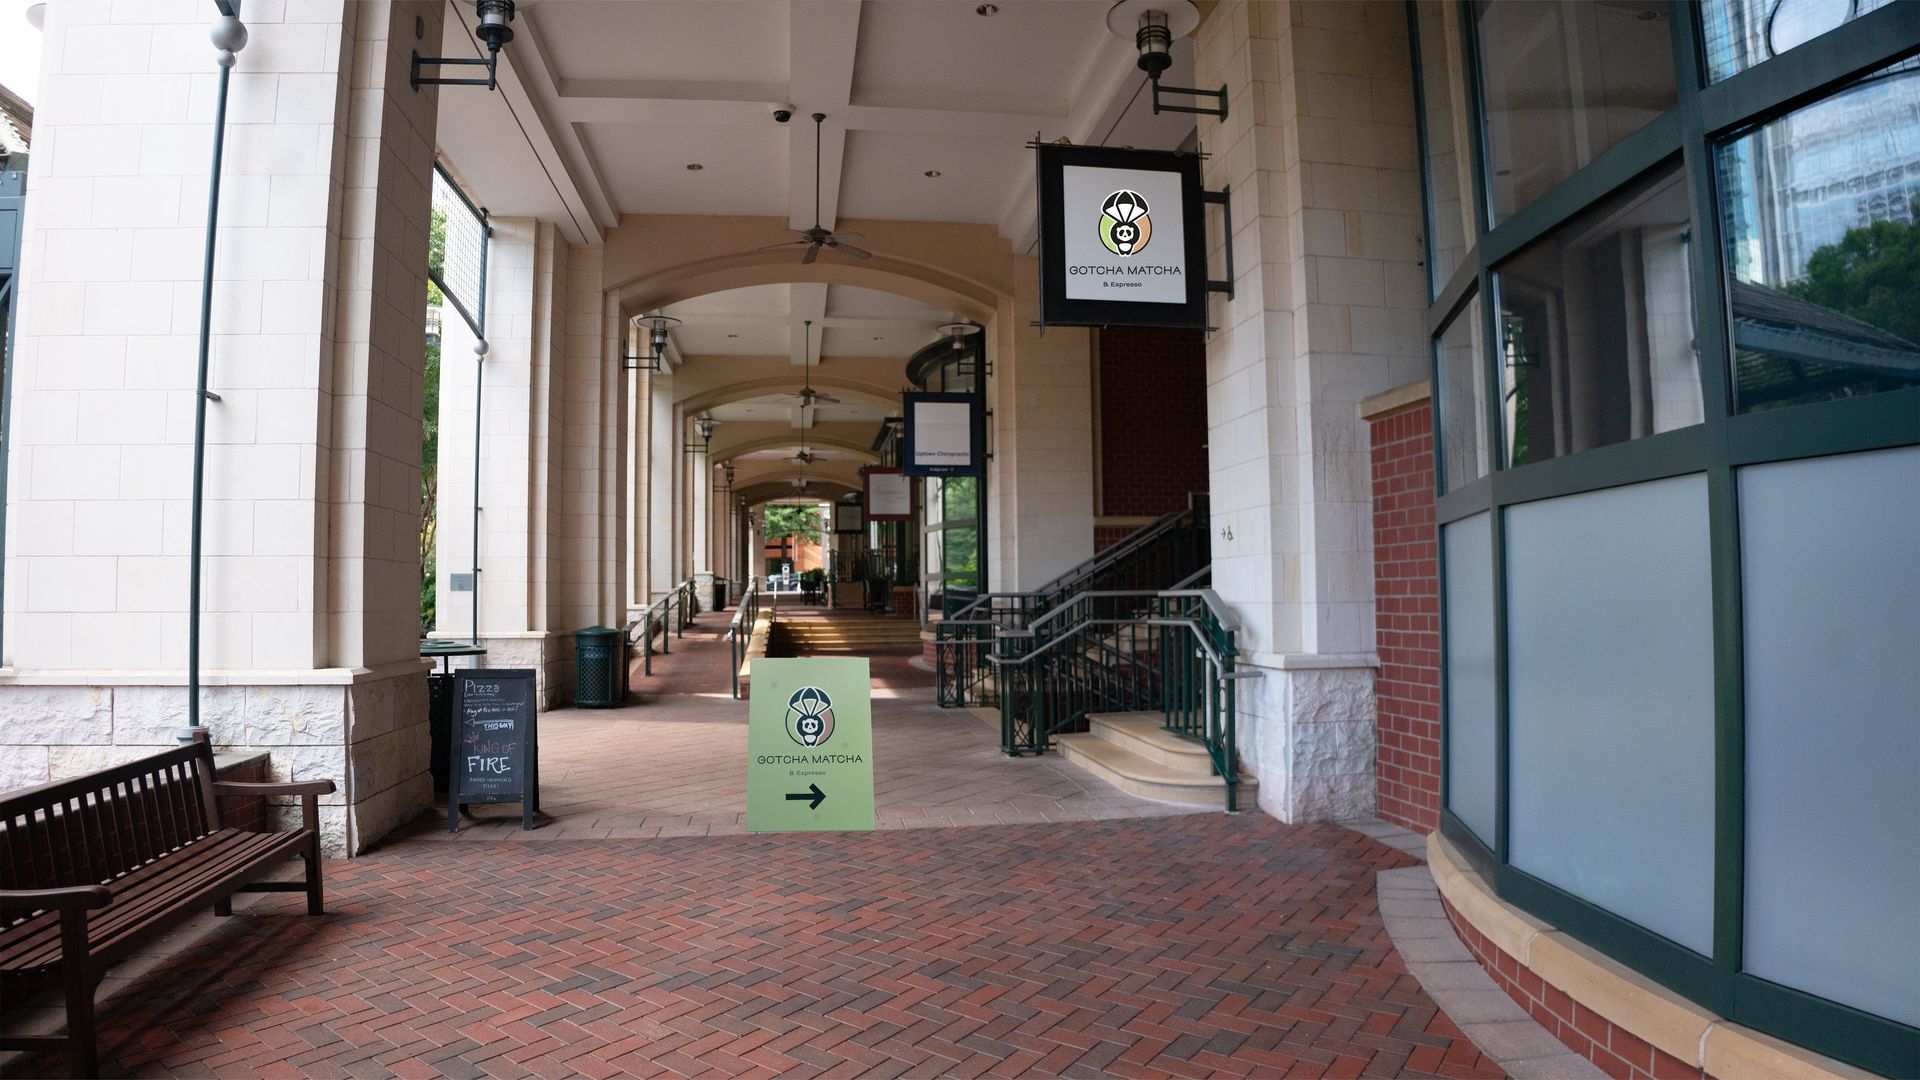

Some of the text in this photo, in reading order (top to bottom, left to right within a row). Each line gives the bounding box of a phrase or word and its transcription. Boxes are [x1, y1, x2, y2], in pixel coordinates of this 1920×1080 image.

[1069, 265, 1182, 275] GOTCHA MATCHA
[473, 739, 517, 755] KING OF
[467, 755, 511, 774] FIRE
[757, 754, 863, 764] GOTCHA MATCHA
